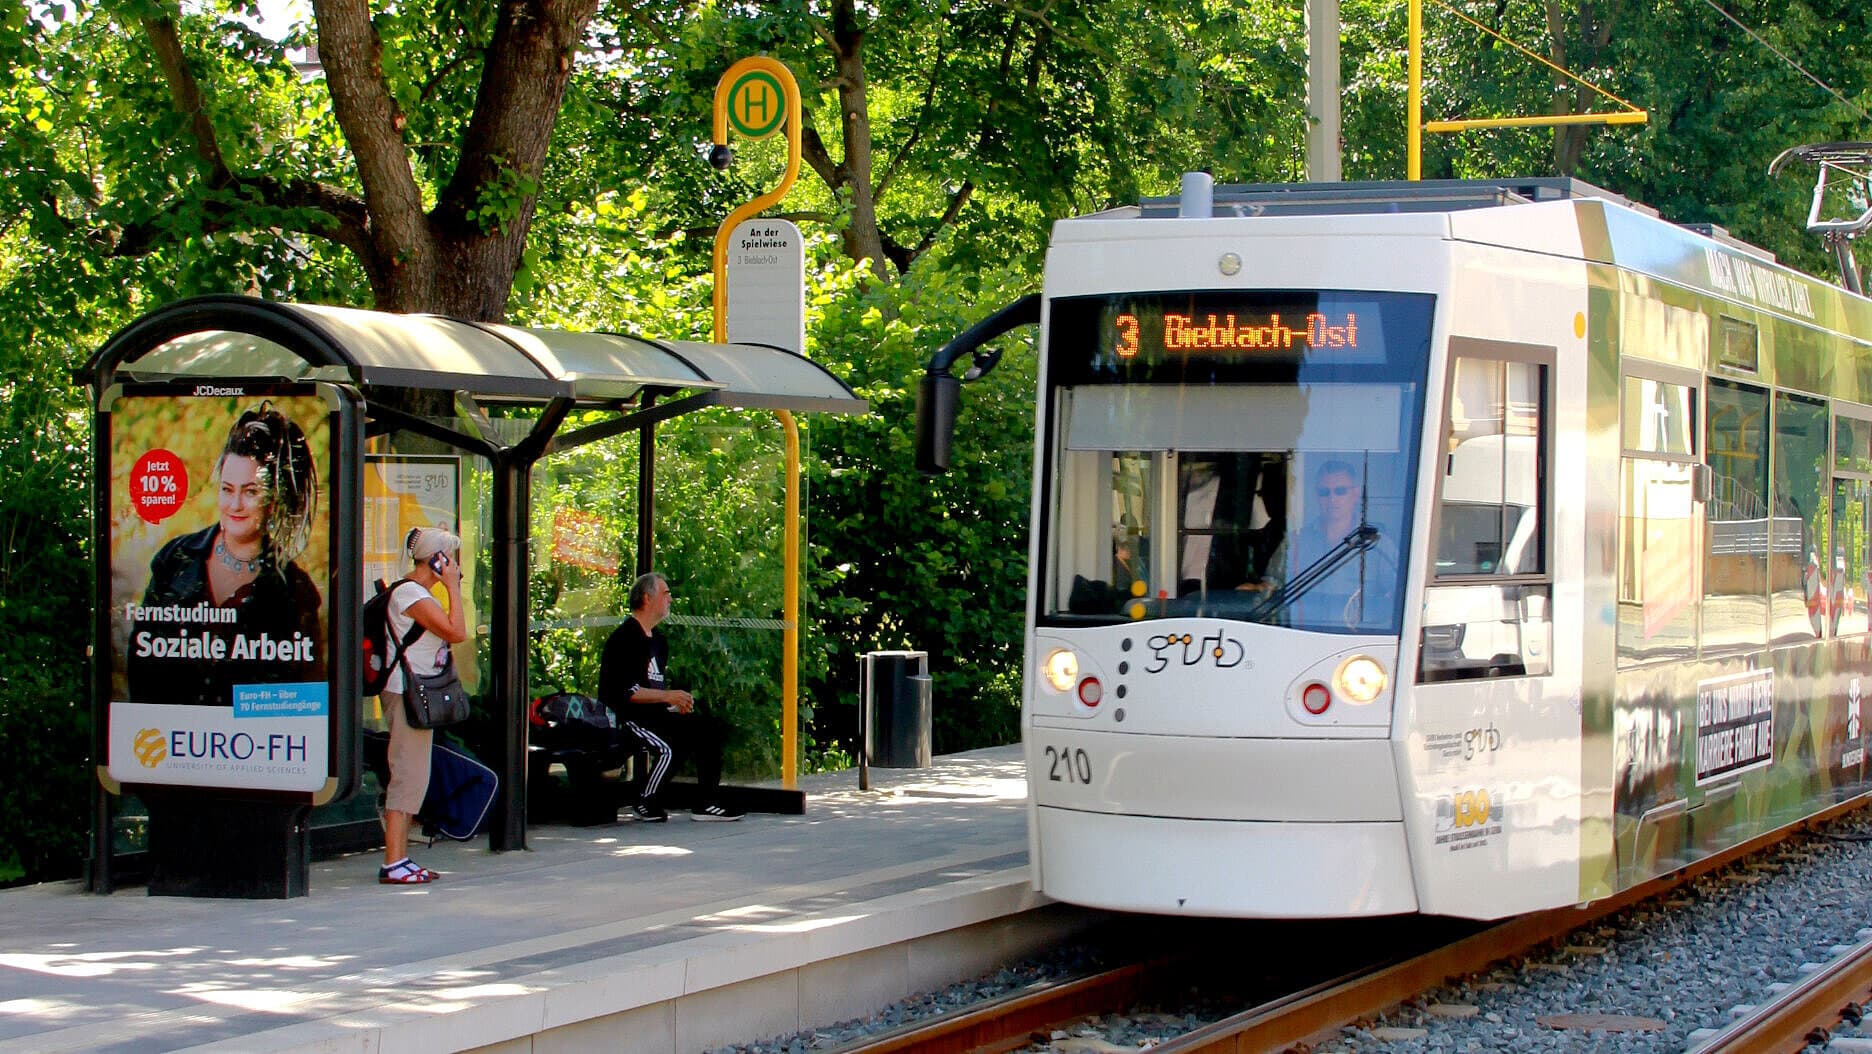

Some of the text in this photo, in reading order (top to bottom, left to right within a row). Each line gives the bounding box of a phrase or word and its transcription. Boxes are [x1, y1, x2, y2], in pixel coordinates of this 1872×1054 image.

[745, 86, 767, 122] H
[750, 227, 779, 237] An der
[741, 239, 788, 251] Spielwiese
[1115, 312, 1359, 359] 3 Bieblach-Ost
[193, 385, 245, 396] JCDecaux
[146, 460, 170, 473] Jetzt
[140, 476, 177, 492] 10 %
[141, 494, 176, 508] sparen!
[125, 602, 238, 623] Fernstudium
[136, 628, 315, 662] Soziale Arbeit
[240, 690, 271, 701] Euro-FH
[278, 689, 297, 699] über
[240, 700, 321, 712] 70 Fernstudiengänge
[1699, 691, 1712, 727] BEI
[1713, 687, 1728, 724] UNS
[170, 730, 307, 762] EURO-FH
[1699, 731, 1734, 773] KARRIERE
[1735, 724, 1757, 763] FAHRT
[167, 762, 307, 775] UNIVERSITY OF APPLIED SCIENCES
[1045, 745, 1093, 785] 210
